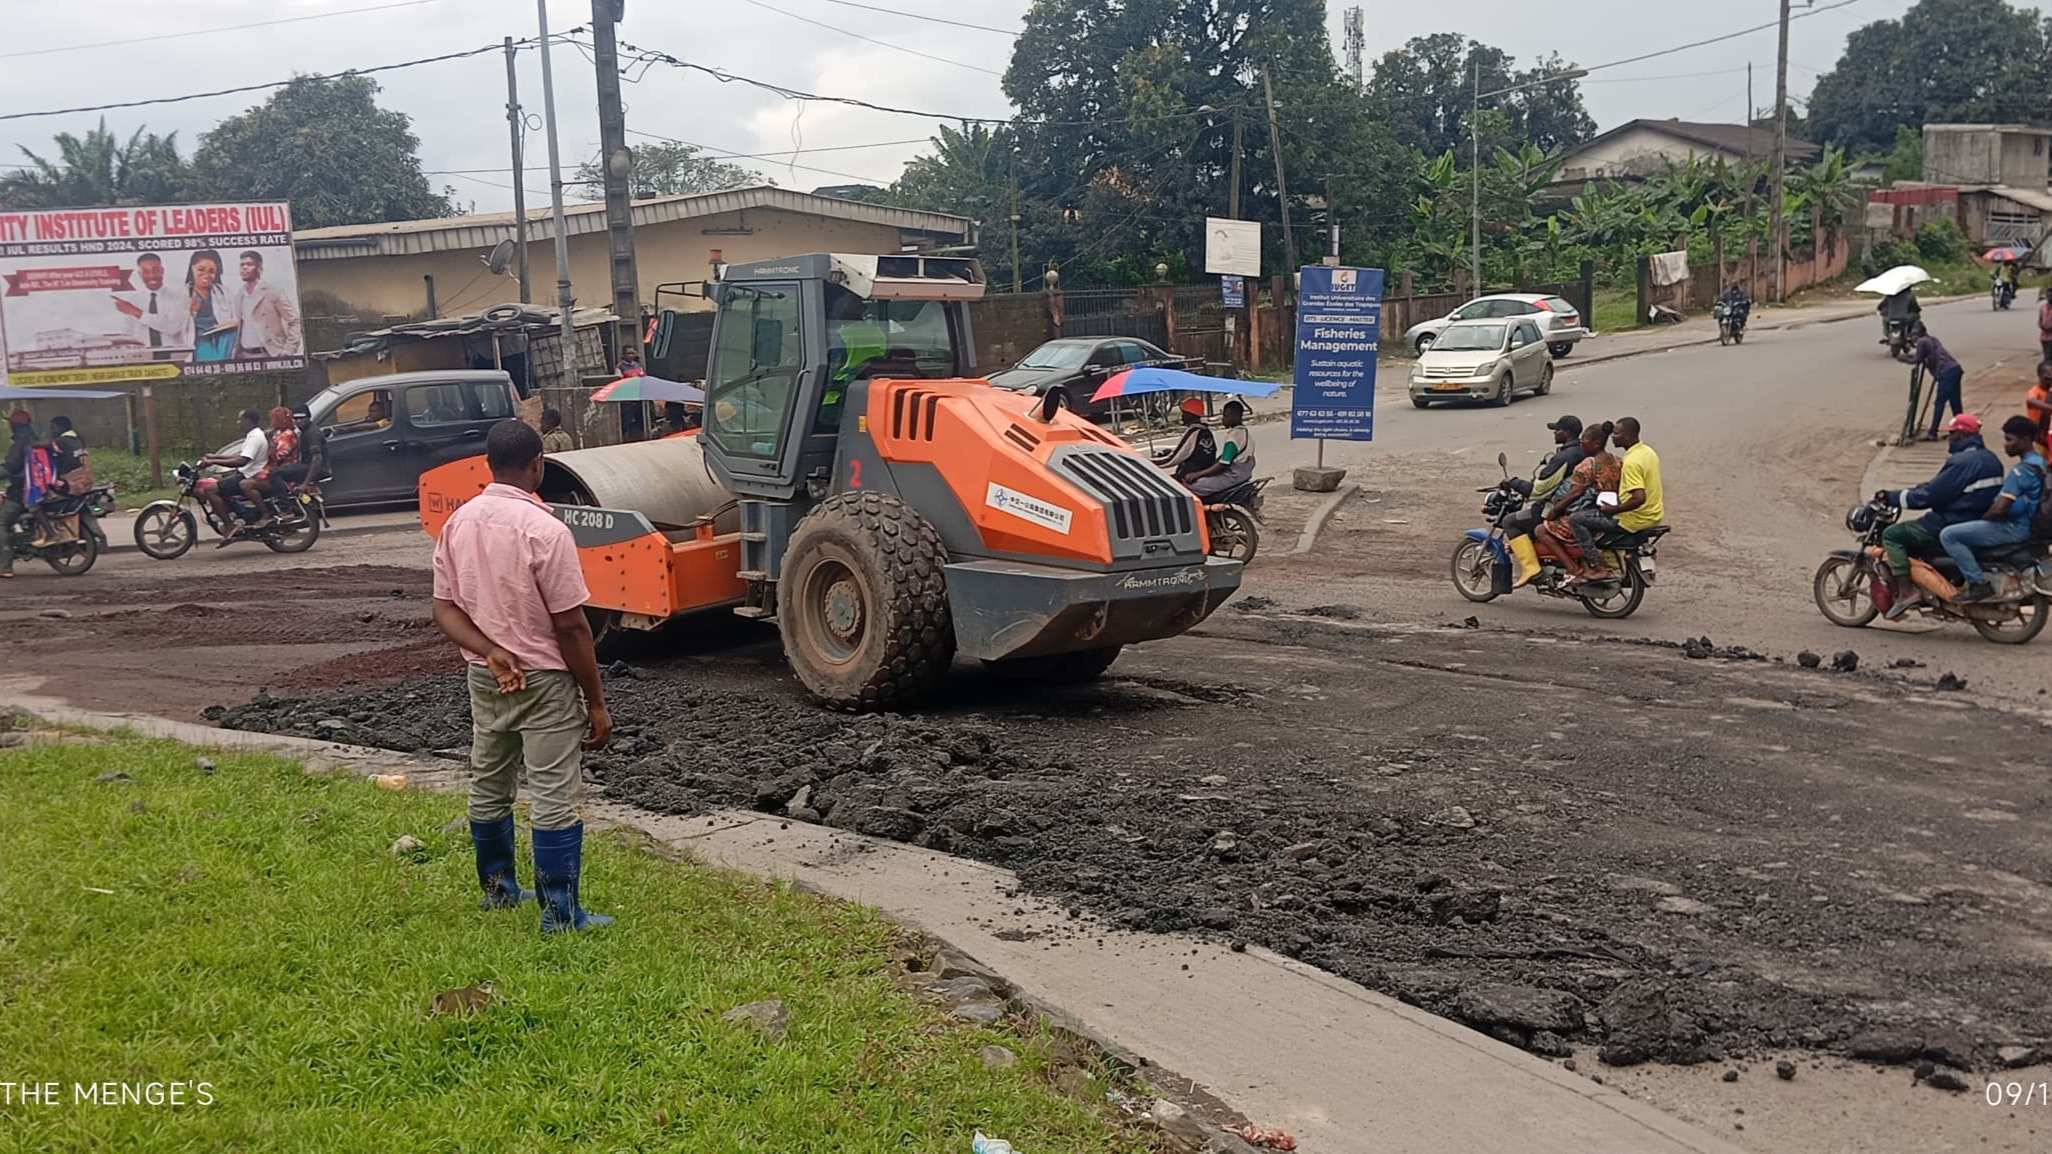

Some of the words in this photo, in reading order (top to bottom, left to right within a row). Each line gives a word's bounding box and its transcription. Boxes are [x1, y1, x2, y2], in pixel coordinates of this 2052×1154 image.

[34, 211, 130, 240] INSTITUTE
[134, 209, 157, 236] OF
[162, 206, 241, 235] LEADERS
[245, 205, 286, 233] (IUL)
[28, 243, 78, 255] RESULTS
[80, 241, 104, 252] HND
[107, 240, 136, 251] 2024,
[138, 239, 182, 250] SCORED
[184, 238, 207, 248] 98%
[209, 236, 258, 247] SUCCESS
[260, 234, 287, 245] RATE
[1314, 328, 1366, 339] Fisheries
[1300, 340, 1378, 353] Management
[1310, 359, 1336, 367] Sustain
[1336, 360, 1364, 369] aquatic
[1352, 370, 1364, 378] the
[1314, 380, 1347, 389] wellbeing
[848, 458, 864, 488] 2
[564, 508, 580, 526] HC
[581, 511, 604, 529] 208
[605, 513, 614, 529] D
